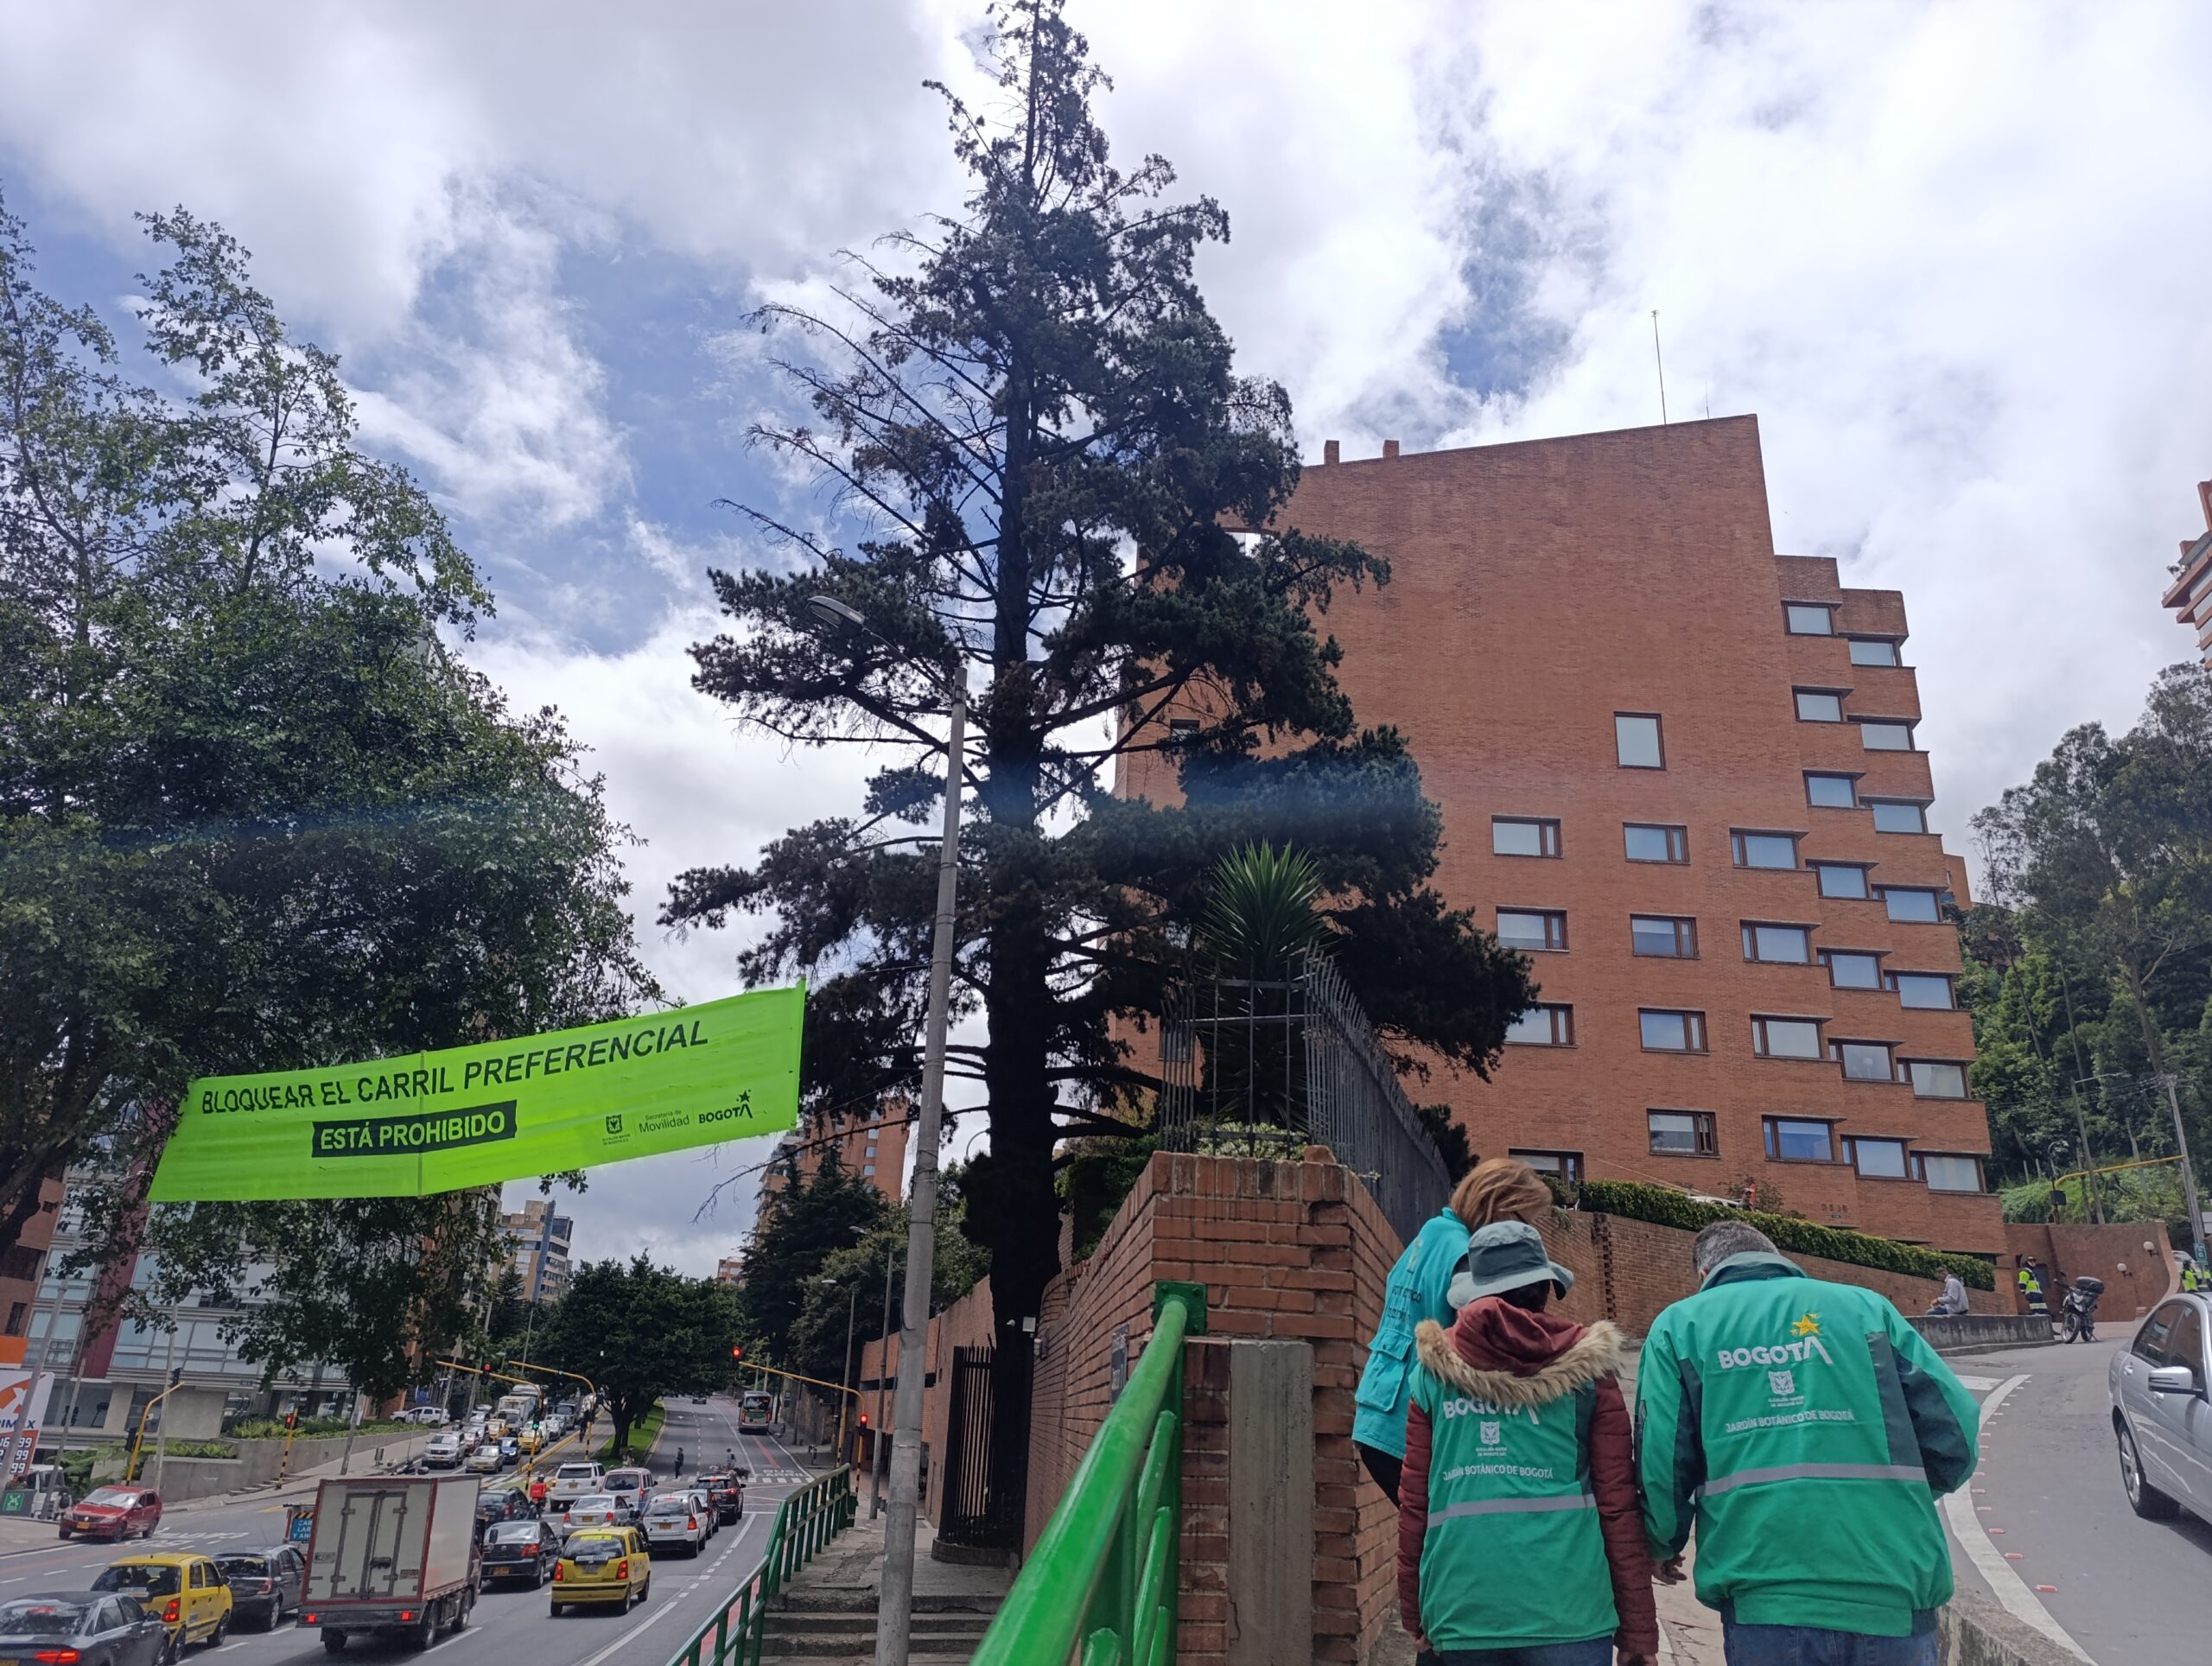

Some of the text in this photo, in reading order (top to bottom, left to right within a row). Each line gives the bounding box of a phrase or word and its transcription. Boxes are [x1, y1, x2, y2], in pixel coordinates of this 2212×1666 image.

[202, 1021, 708, 1114] BLOQUEAR EL CARRIL PREFERENCIAL
[321, 1110, 505, 1149] ESTÁ PROHIBIDO
[639, 1116, 690, 1133] Movilidad
[1725, 1417, 1758, 1433] JARDÍN
[1758, 1413, 1804, 1427] BOTÁNICO
[1805, 1411, 1818, 1421] DE
[1465, 1463, 1505, 1476] BOTÁNICO
[1506, 1466, 1517, 1475] DE
[1520, 1466, 1554, 1479] BOGOTÁ
